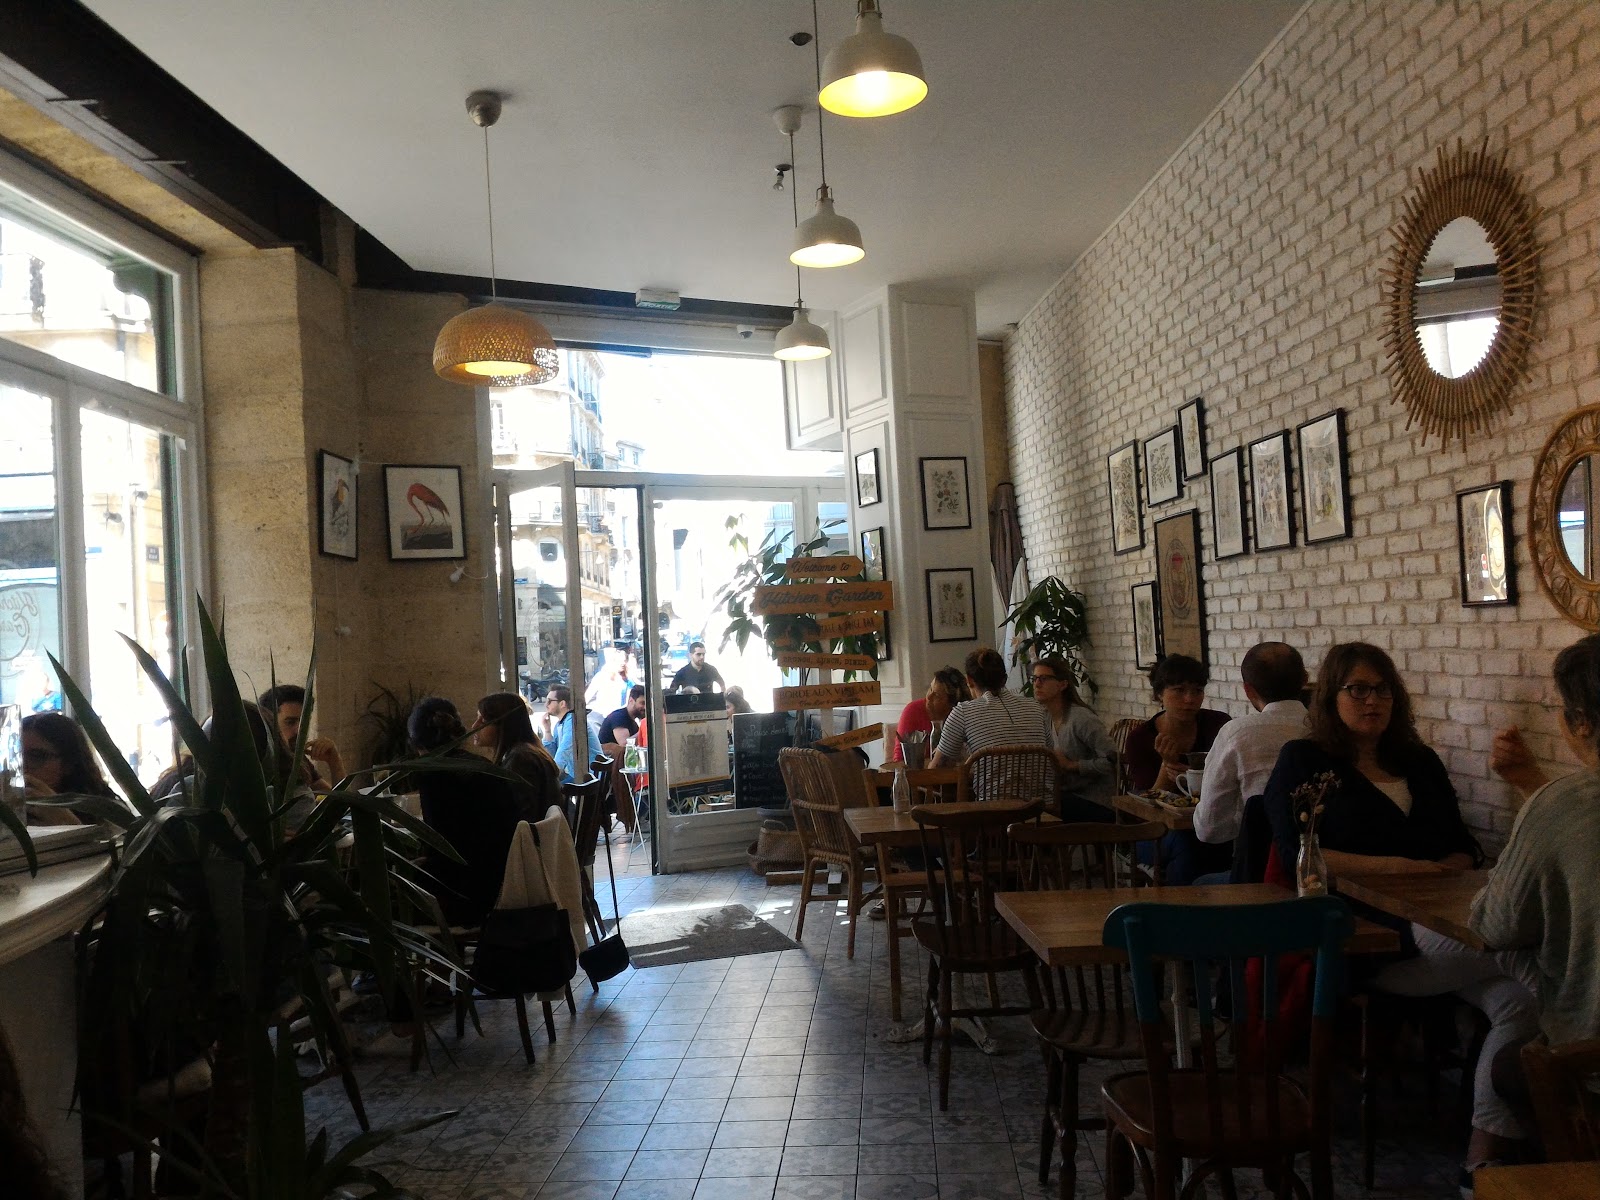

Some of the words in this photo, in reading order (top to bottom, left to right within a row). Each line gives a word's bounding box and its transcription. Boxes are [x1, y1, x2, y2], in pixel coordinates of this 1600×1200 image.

[791, 561, 836, 574] Welcome
[840, 562, 850, 571] to
[761, 591, 819, 608] Kitchen
[826, 588, 884, 607] Garden
[781, 687, 833, 699] BORDEAUX
